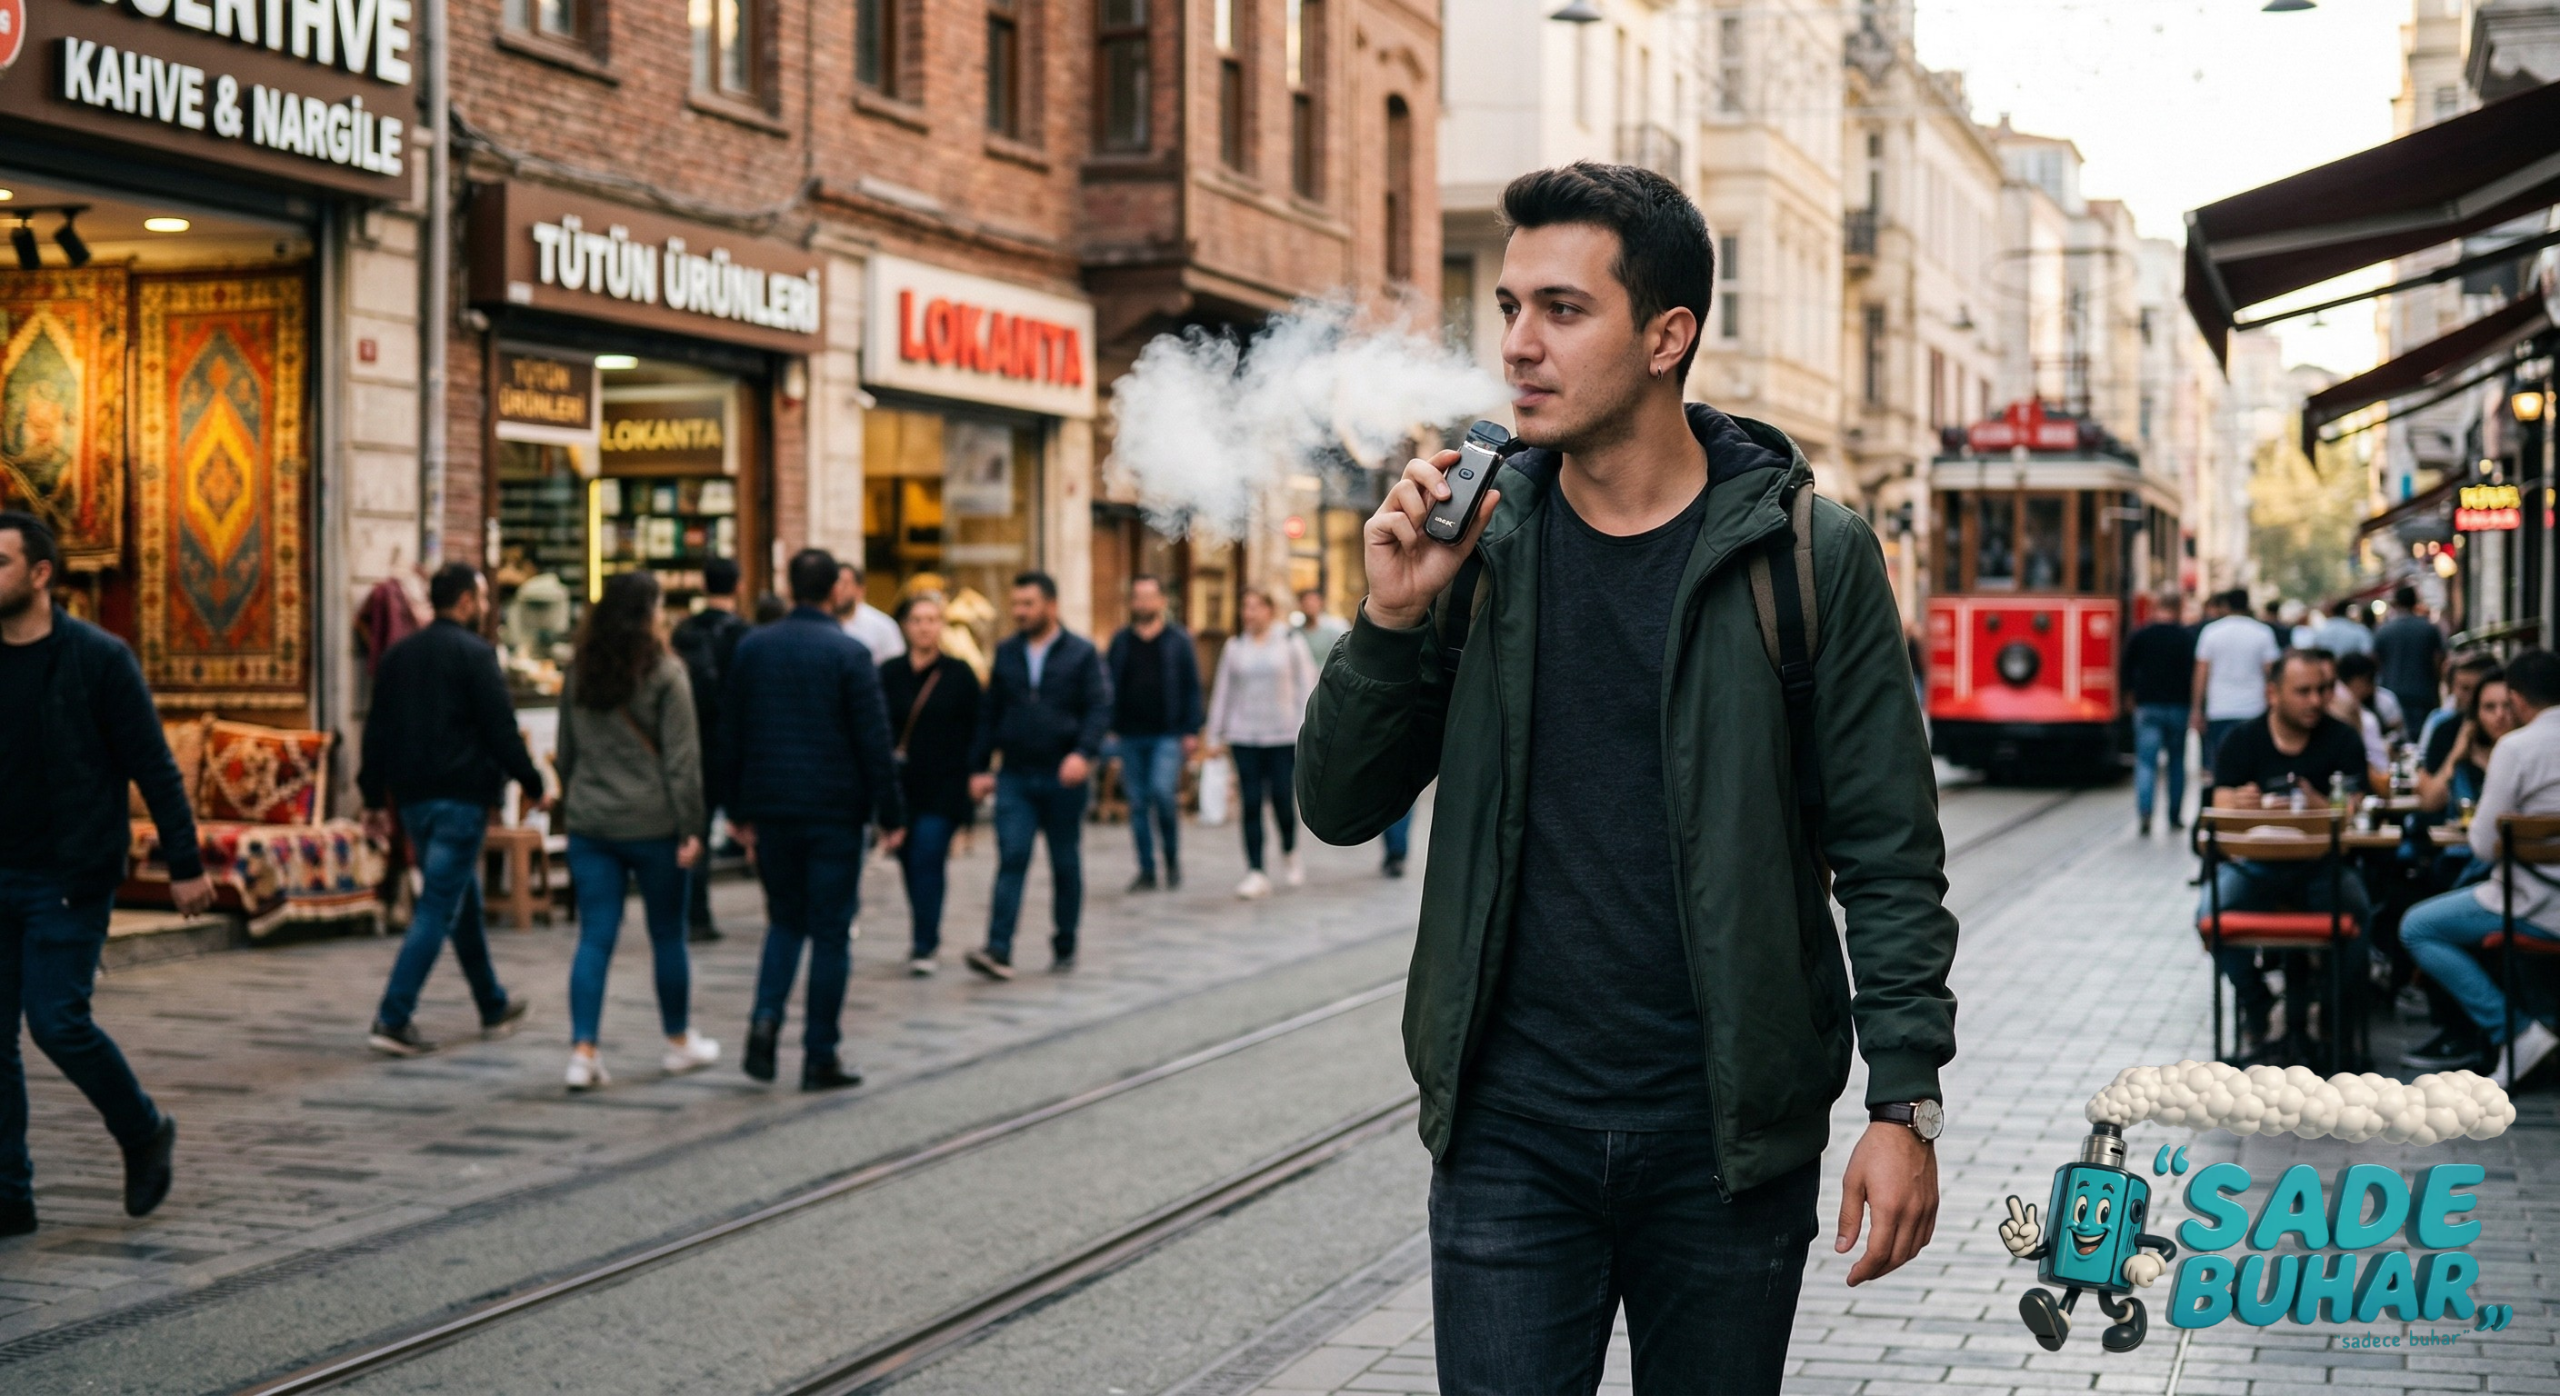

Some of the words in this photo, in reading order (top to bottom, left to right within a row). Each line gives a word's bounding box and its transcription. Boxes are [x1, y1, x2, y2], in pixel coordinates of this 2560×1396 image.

[65, 36, 205, 130] KAHVE
[213, 74, 243, 138] &
[253, 84, 403, 177] NARGİLE
[533, 213, 657, 304] TÜTÜN
[663, 236, 820, 334] ÜRÜNLERİ
[898, 289, 1084, 387] LOKANTA
[600, 417, 724, 452] LOKANTA
